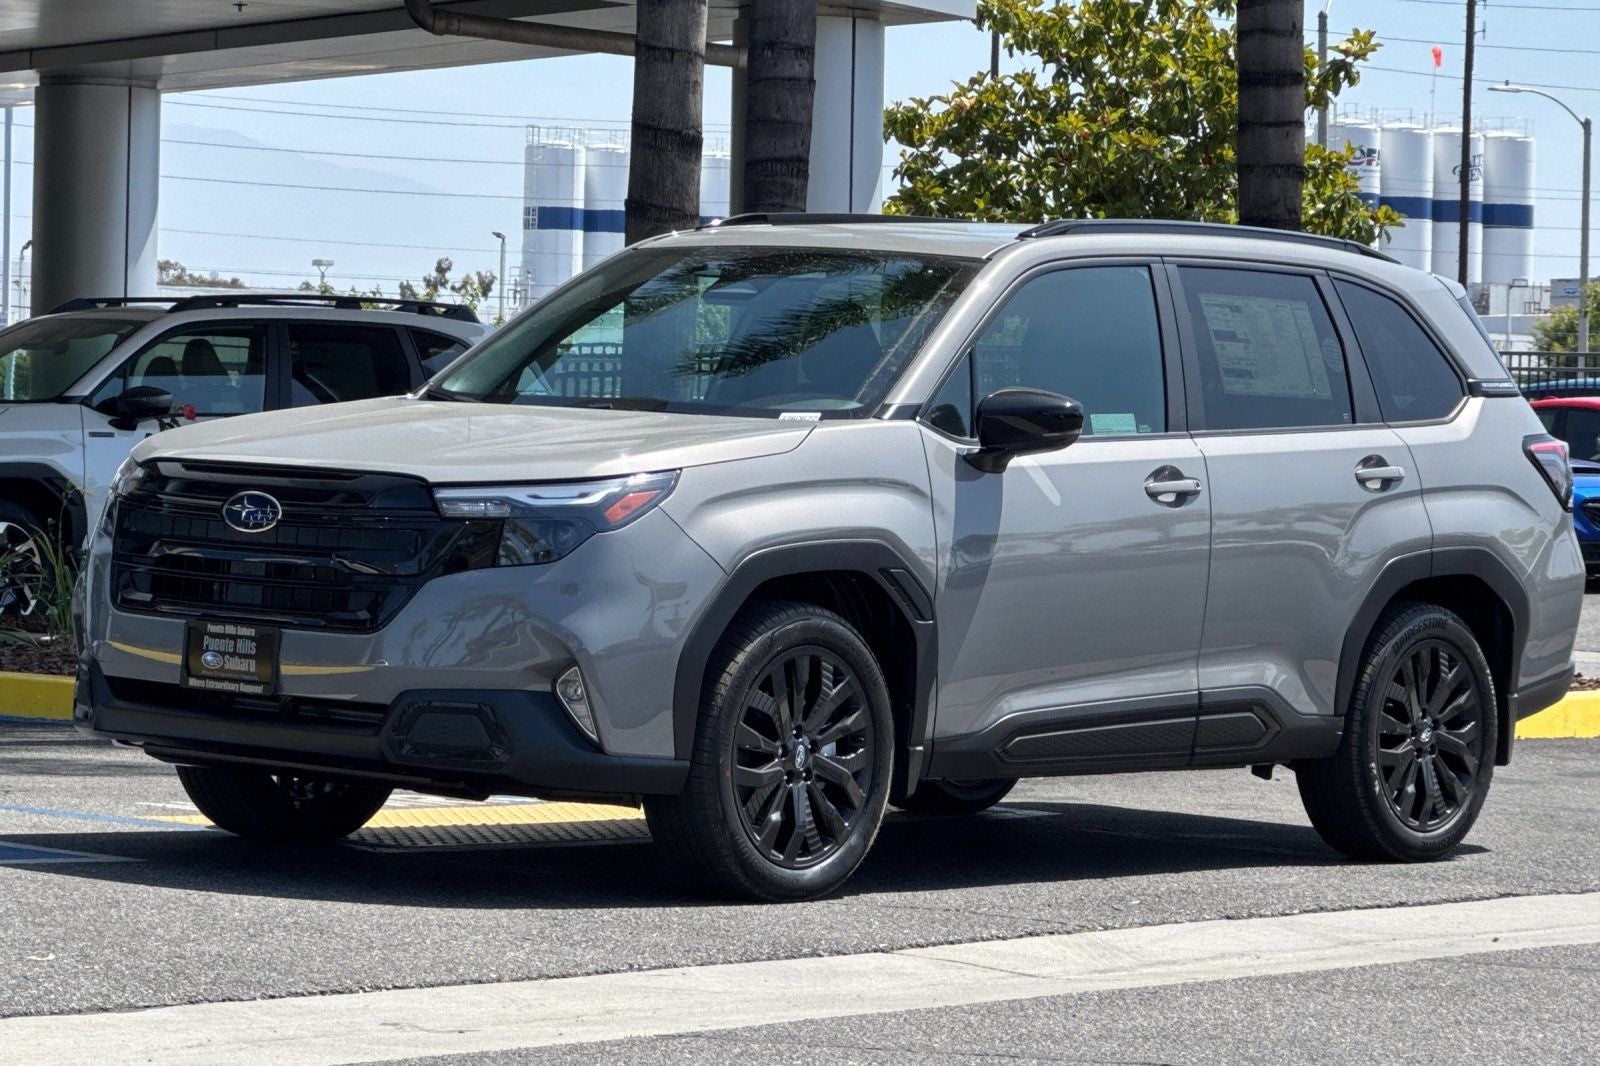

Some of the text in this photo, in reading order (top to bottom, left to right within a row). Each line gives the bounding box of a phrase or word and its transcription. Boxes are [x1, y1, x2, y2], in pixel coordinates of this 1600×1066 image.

[237, 626, 255, 637] Subaru
[203, 635, 257, 655] Puente Hills
[224, 655, 256, 672] Subaru
[188, 678, 206, 688] Where
[206, 679, 239, 692] Extraordinary
